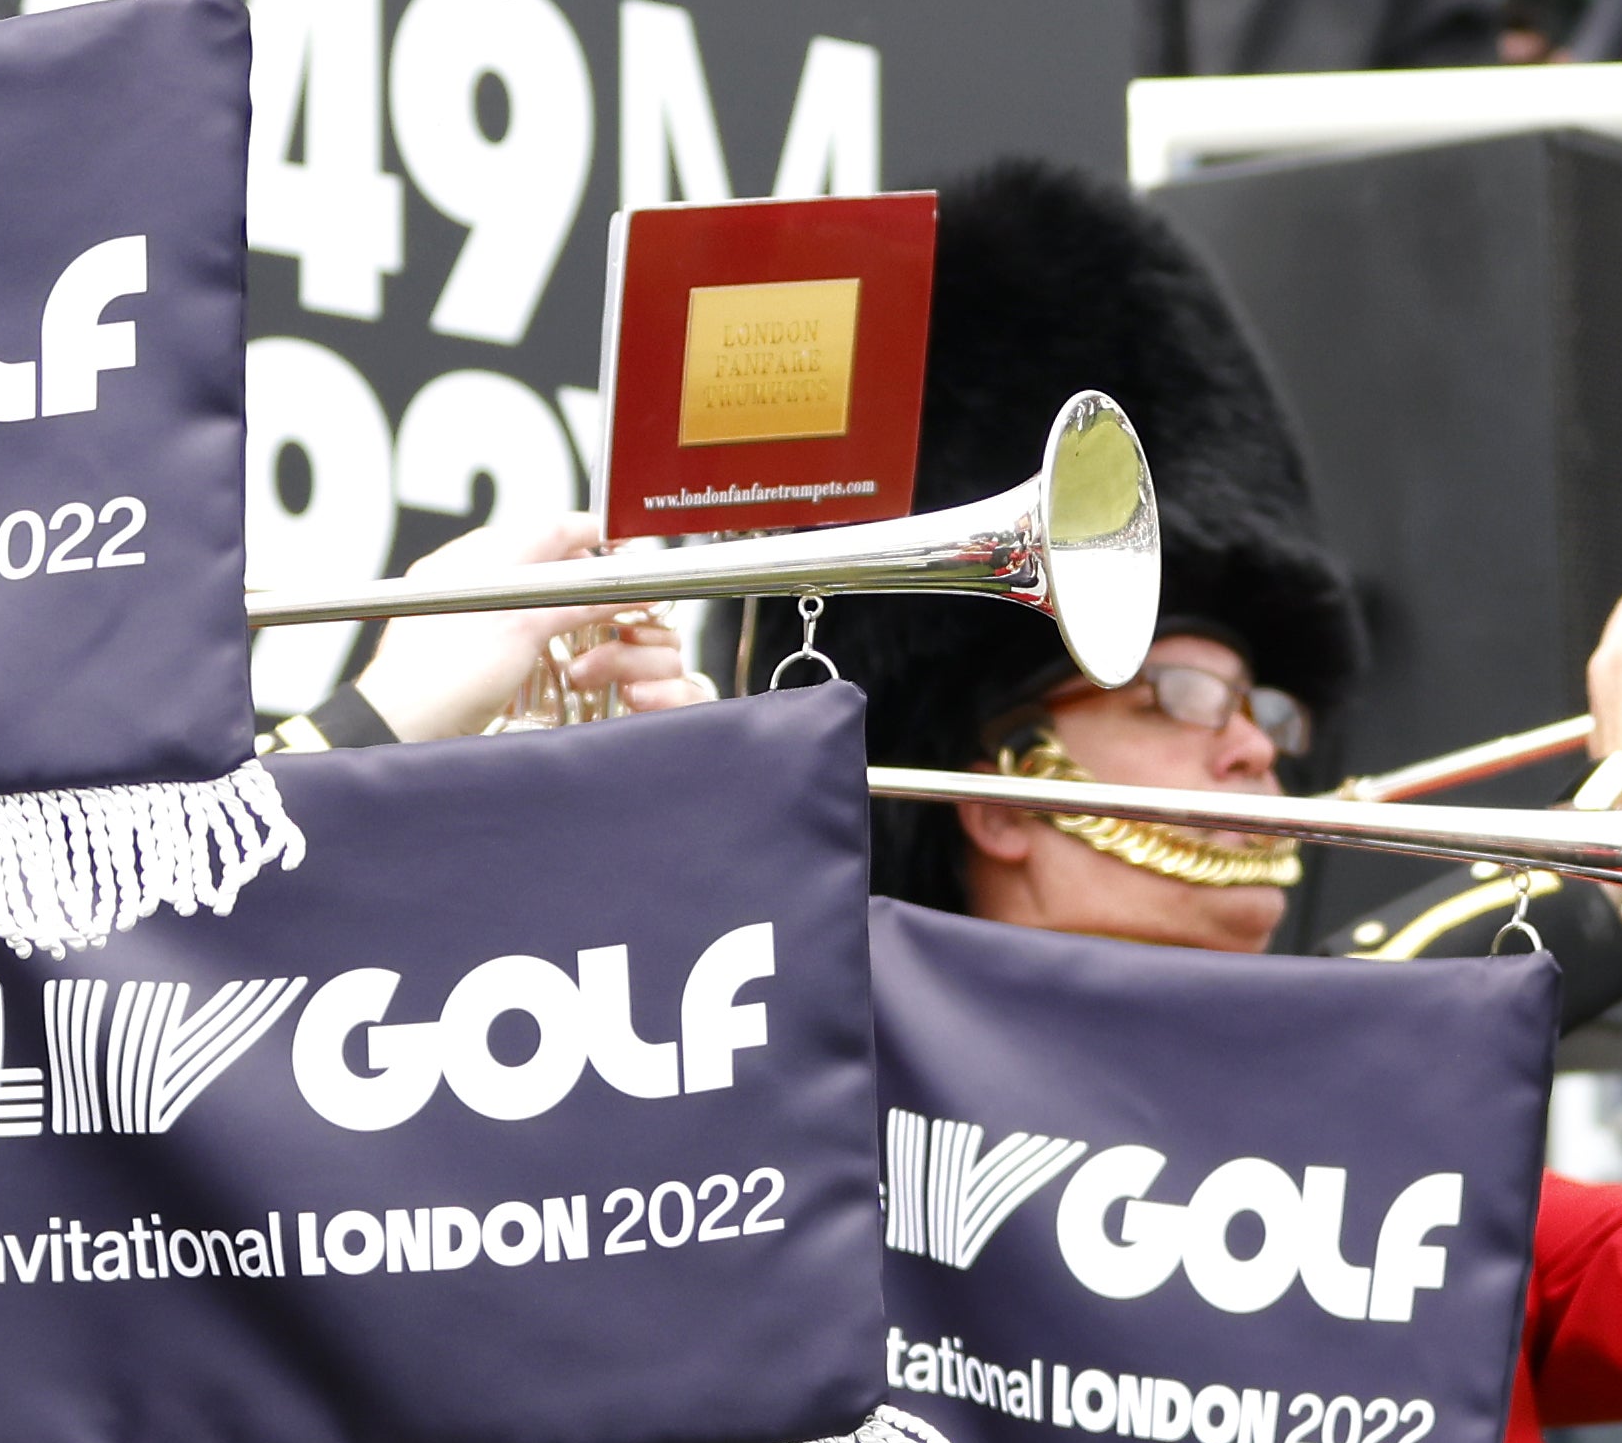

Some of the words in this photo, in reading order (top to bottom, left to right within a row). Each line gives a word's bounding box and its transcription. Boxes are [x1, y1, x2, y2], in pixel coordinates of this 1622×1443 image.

[715, 349, 822, 379] FANFARE
[722, 320, 821, 349] LONDON
[705, 379, 830, 409] TRUMPETS
[644, 478, 877, 509] www.londonfanfaretrumpets.com
[292, 921, 775, 1132] GOLF
[297, 1194, 589, 1276] LONDON
[602, 1166, 786, 1255] 2022
[879, 1107, 1088, 1269] IV
[1057, 1144, 1464, 1322] GOLF
[886, 1326, 1043, 1423] tational
